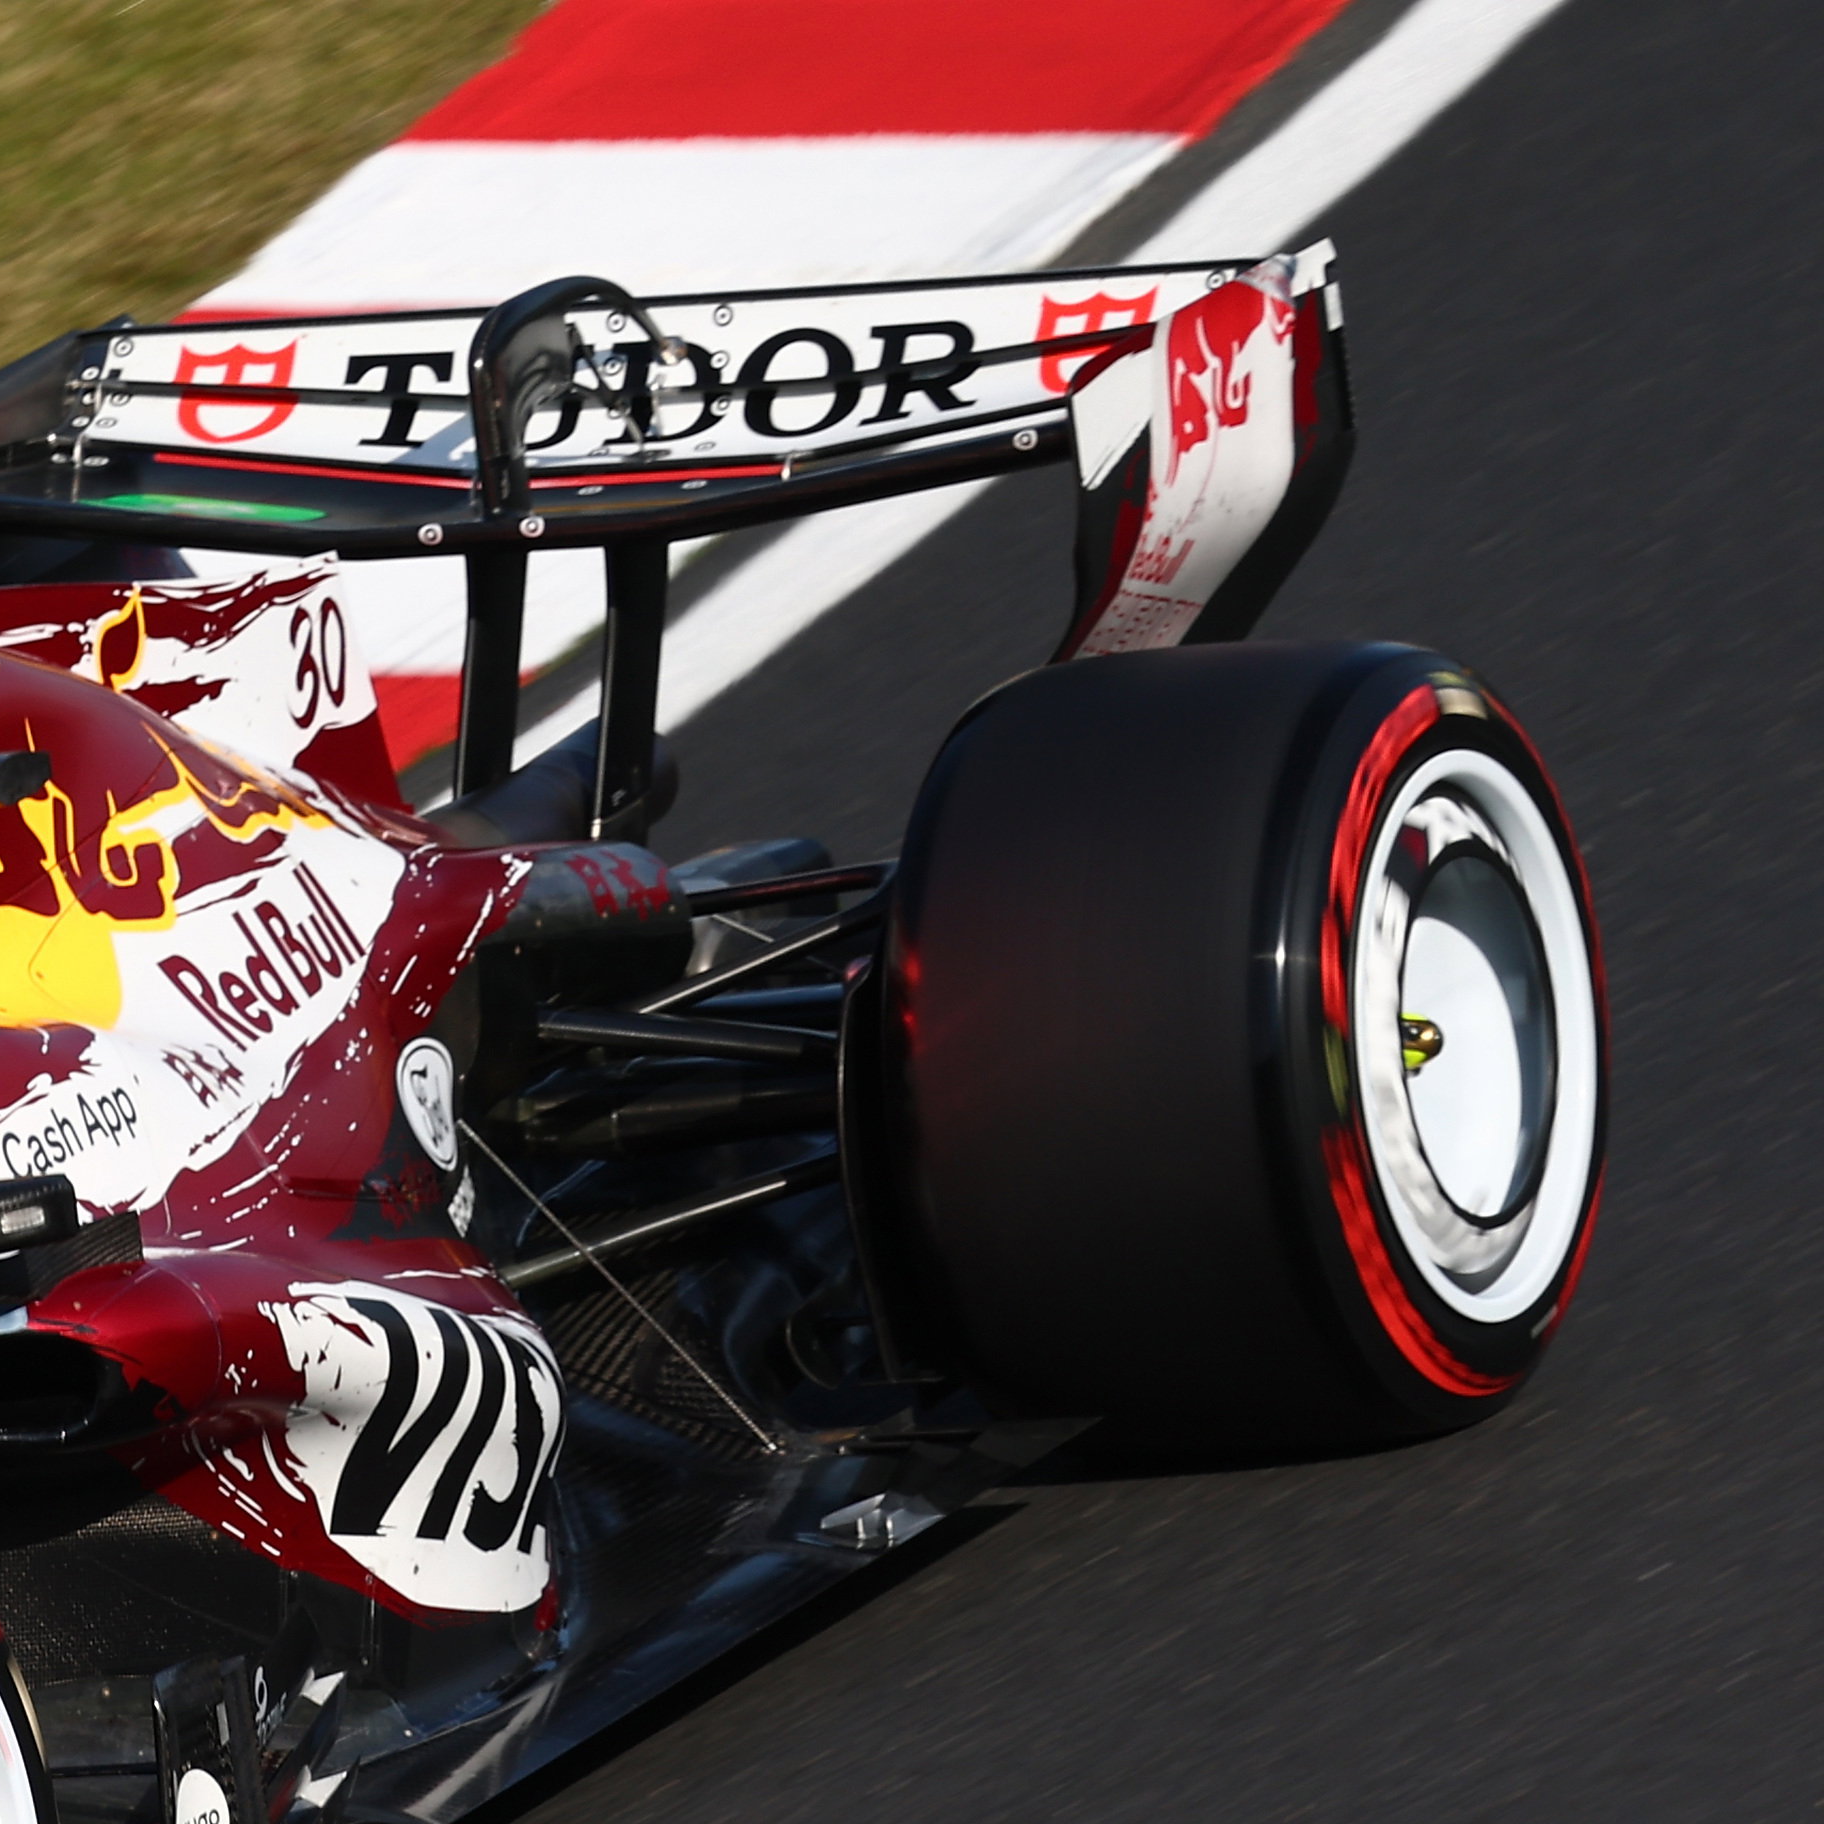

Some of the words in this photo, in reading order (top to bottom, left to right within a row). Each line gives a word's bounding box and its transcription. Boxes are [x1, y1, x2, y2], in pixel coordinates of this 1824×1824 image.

[288, 595, 348, 730] 30
[158, 905, 299, 1050] Red
[267, 864, 366, 1000] Bull
[2, 1108, 85, 1178] Cash
[76, 1086, 138, 1146] App
